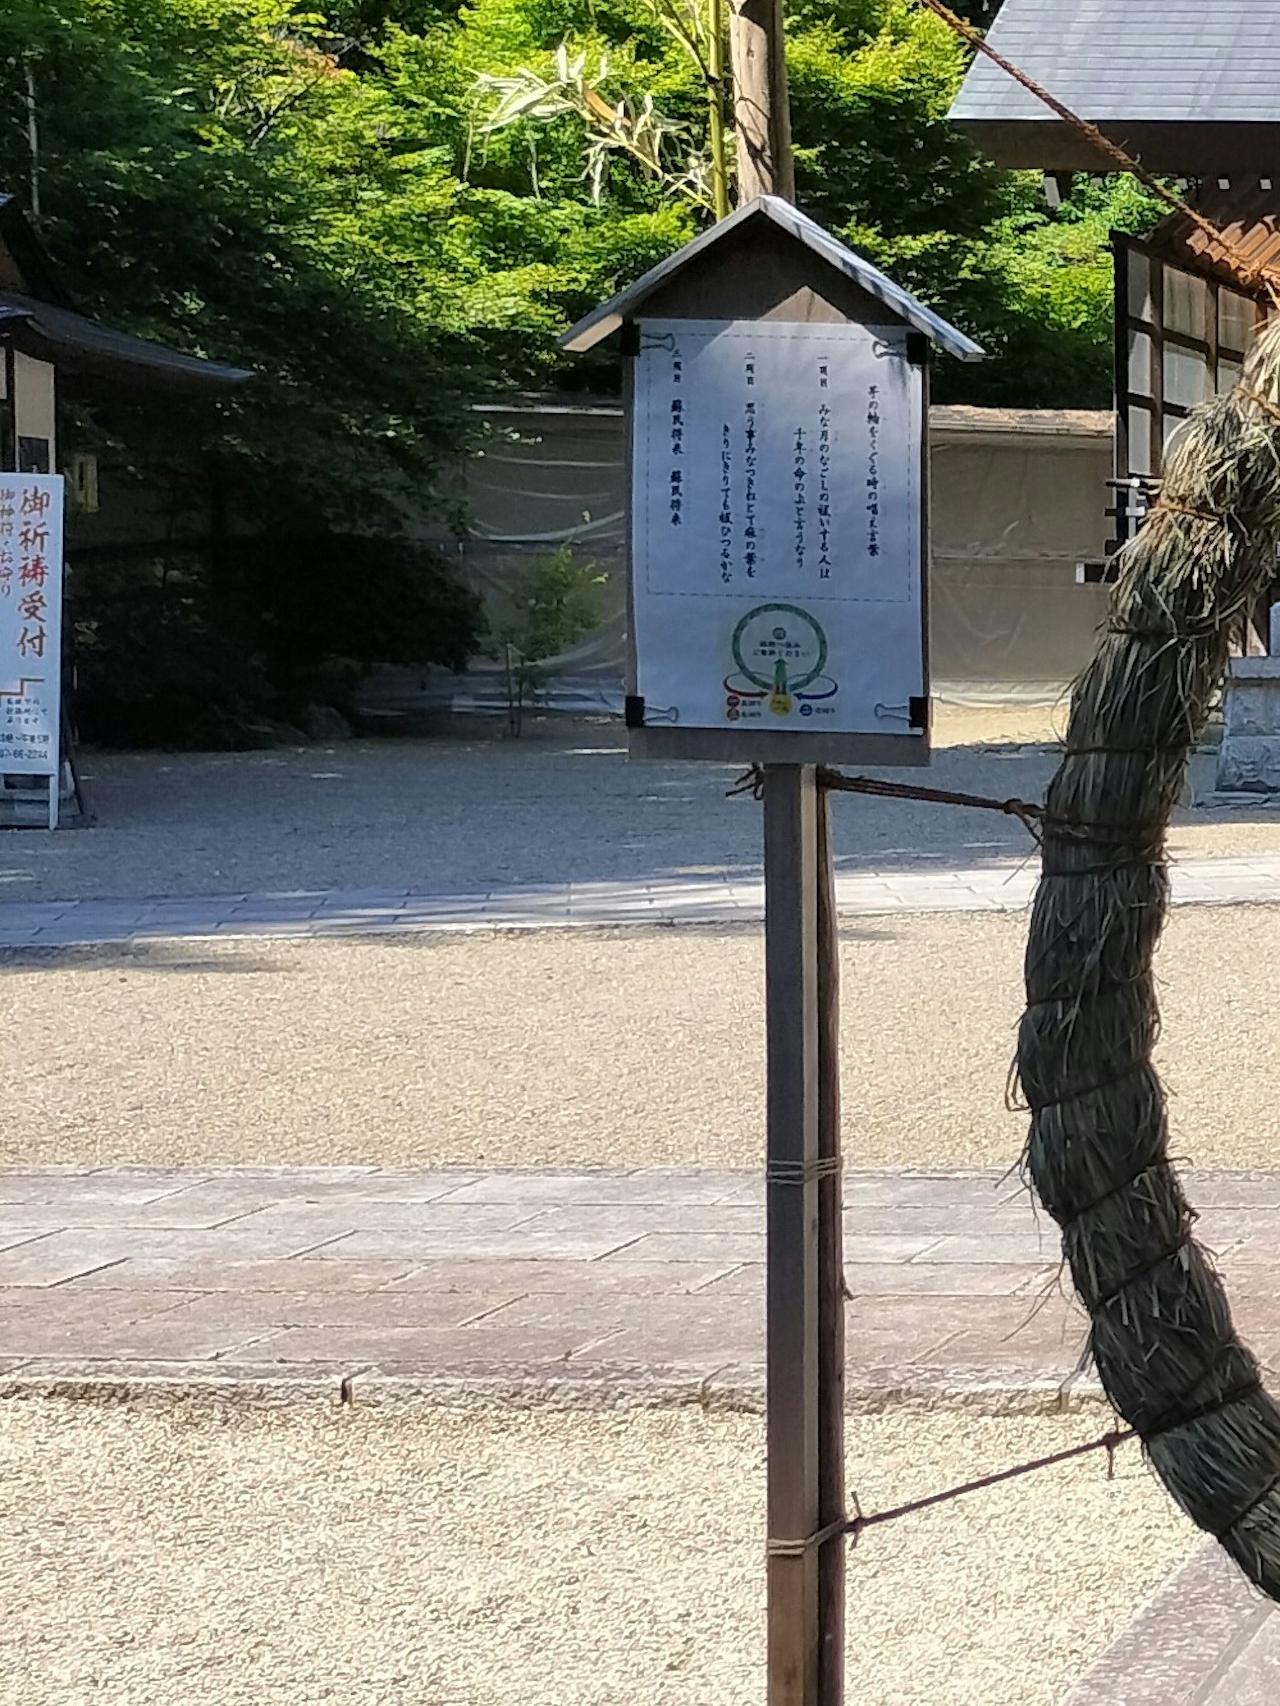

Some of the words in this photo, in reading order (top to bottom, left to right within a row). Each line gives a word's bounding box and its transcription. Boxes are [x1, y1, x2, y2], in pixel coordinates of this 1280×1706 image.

[17, 484, 50, 658] 御祈祷受付
